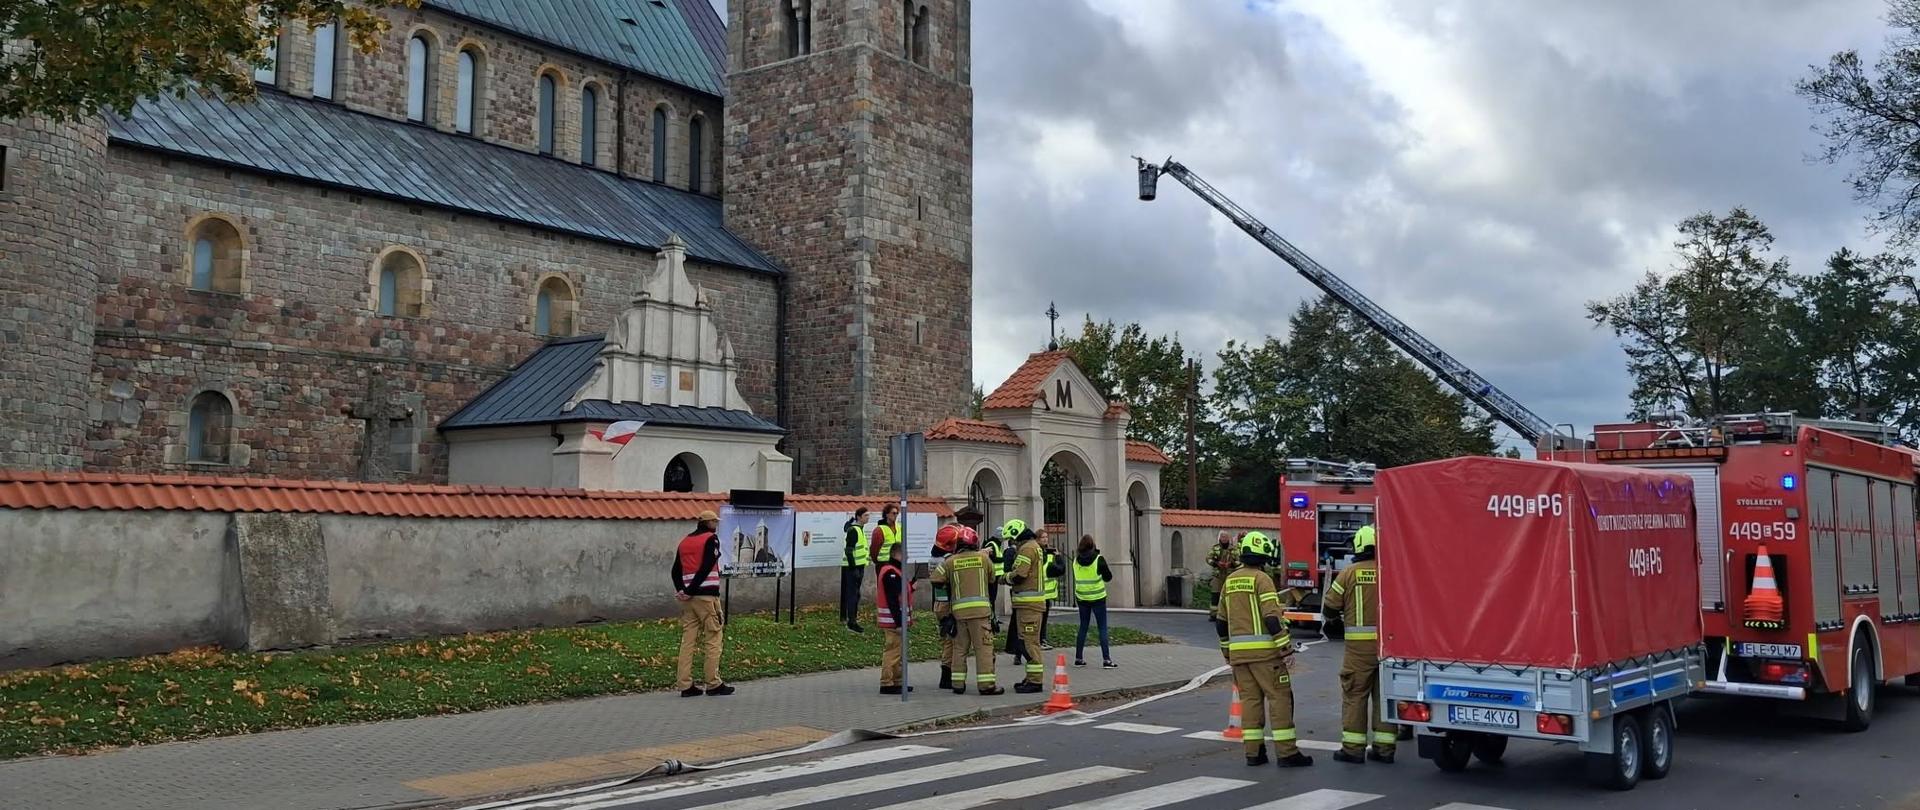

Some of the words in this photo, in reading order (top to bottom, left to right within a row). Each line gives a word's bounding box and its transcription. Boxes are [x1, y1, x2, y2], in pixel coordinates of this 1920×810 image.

[1056, 379, 1073, 409] M
[1736, 498, 1783, 506] STOLARCZYK
[1745, 643, 1767, 655] ELE
[1770, 645, 1798, 657] 9LM7
[1457, 706, 1479, 721] ELE
[1484, 709, 1514, 724] 4KV6
